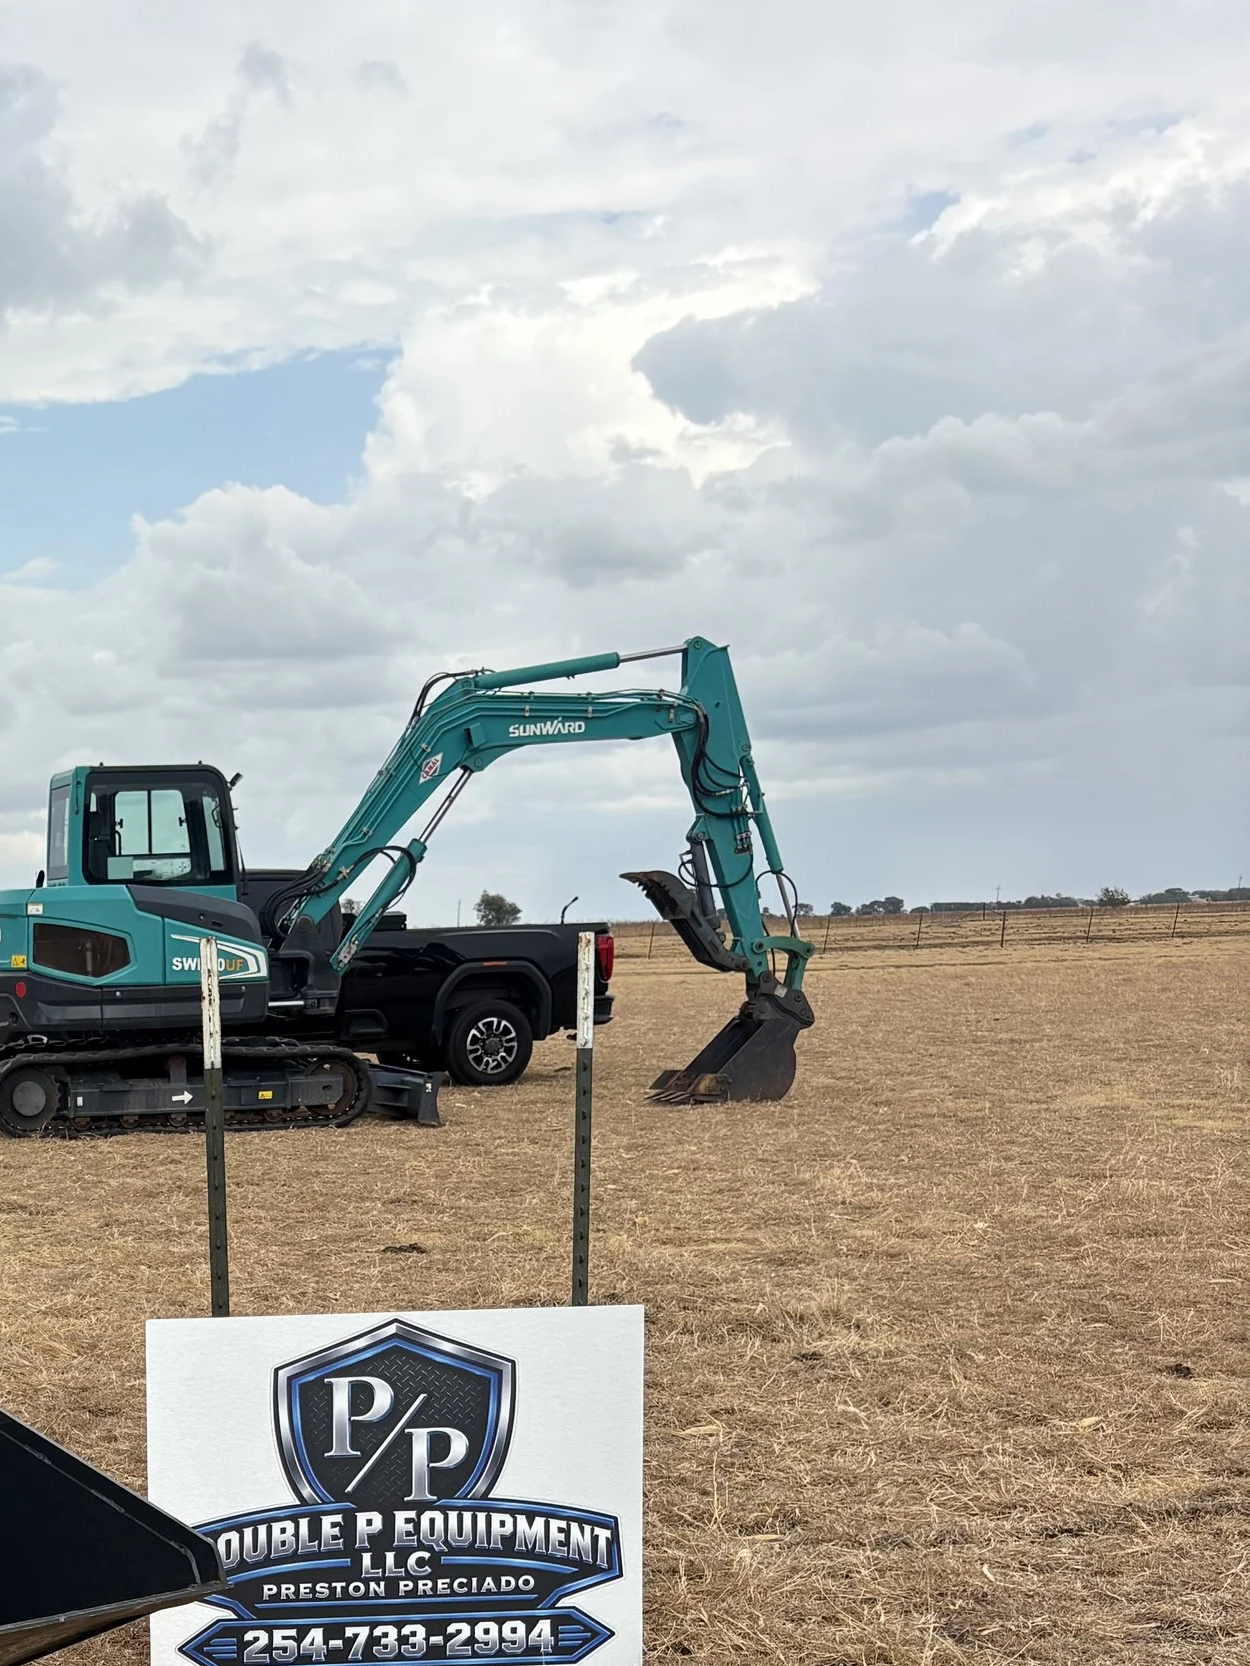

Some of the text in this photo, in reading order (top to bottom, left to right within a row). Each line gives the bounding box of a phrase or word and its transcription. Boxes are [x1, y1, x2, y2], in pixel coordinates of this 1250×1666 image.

[508, 717, 585, 738] SUNWARD
[171, 957, 244, 971] SW0UF
[216, 1509, 613, 1570] OUBLE P EQUIPMENT
[360, 1550, 432, 1578] LLC
[261, 1574, 537, 1602] PRESTON PRECIADO
[243, 1618, 555, 1664] 254-733-2994
